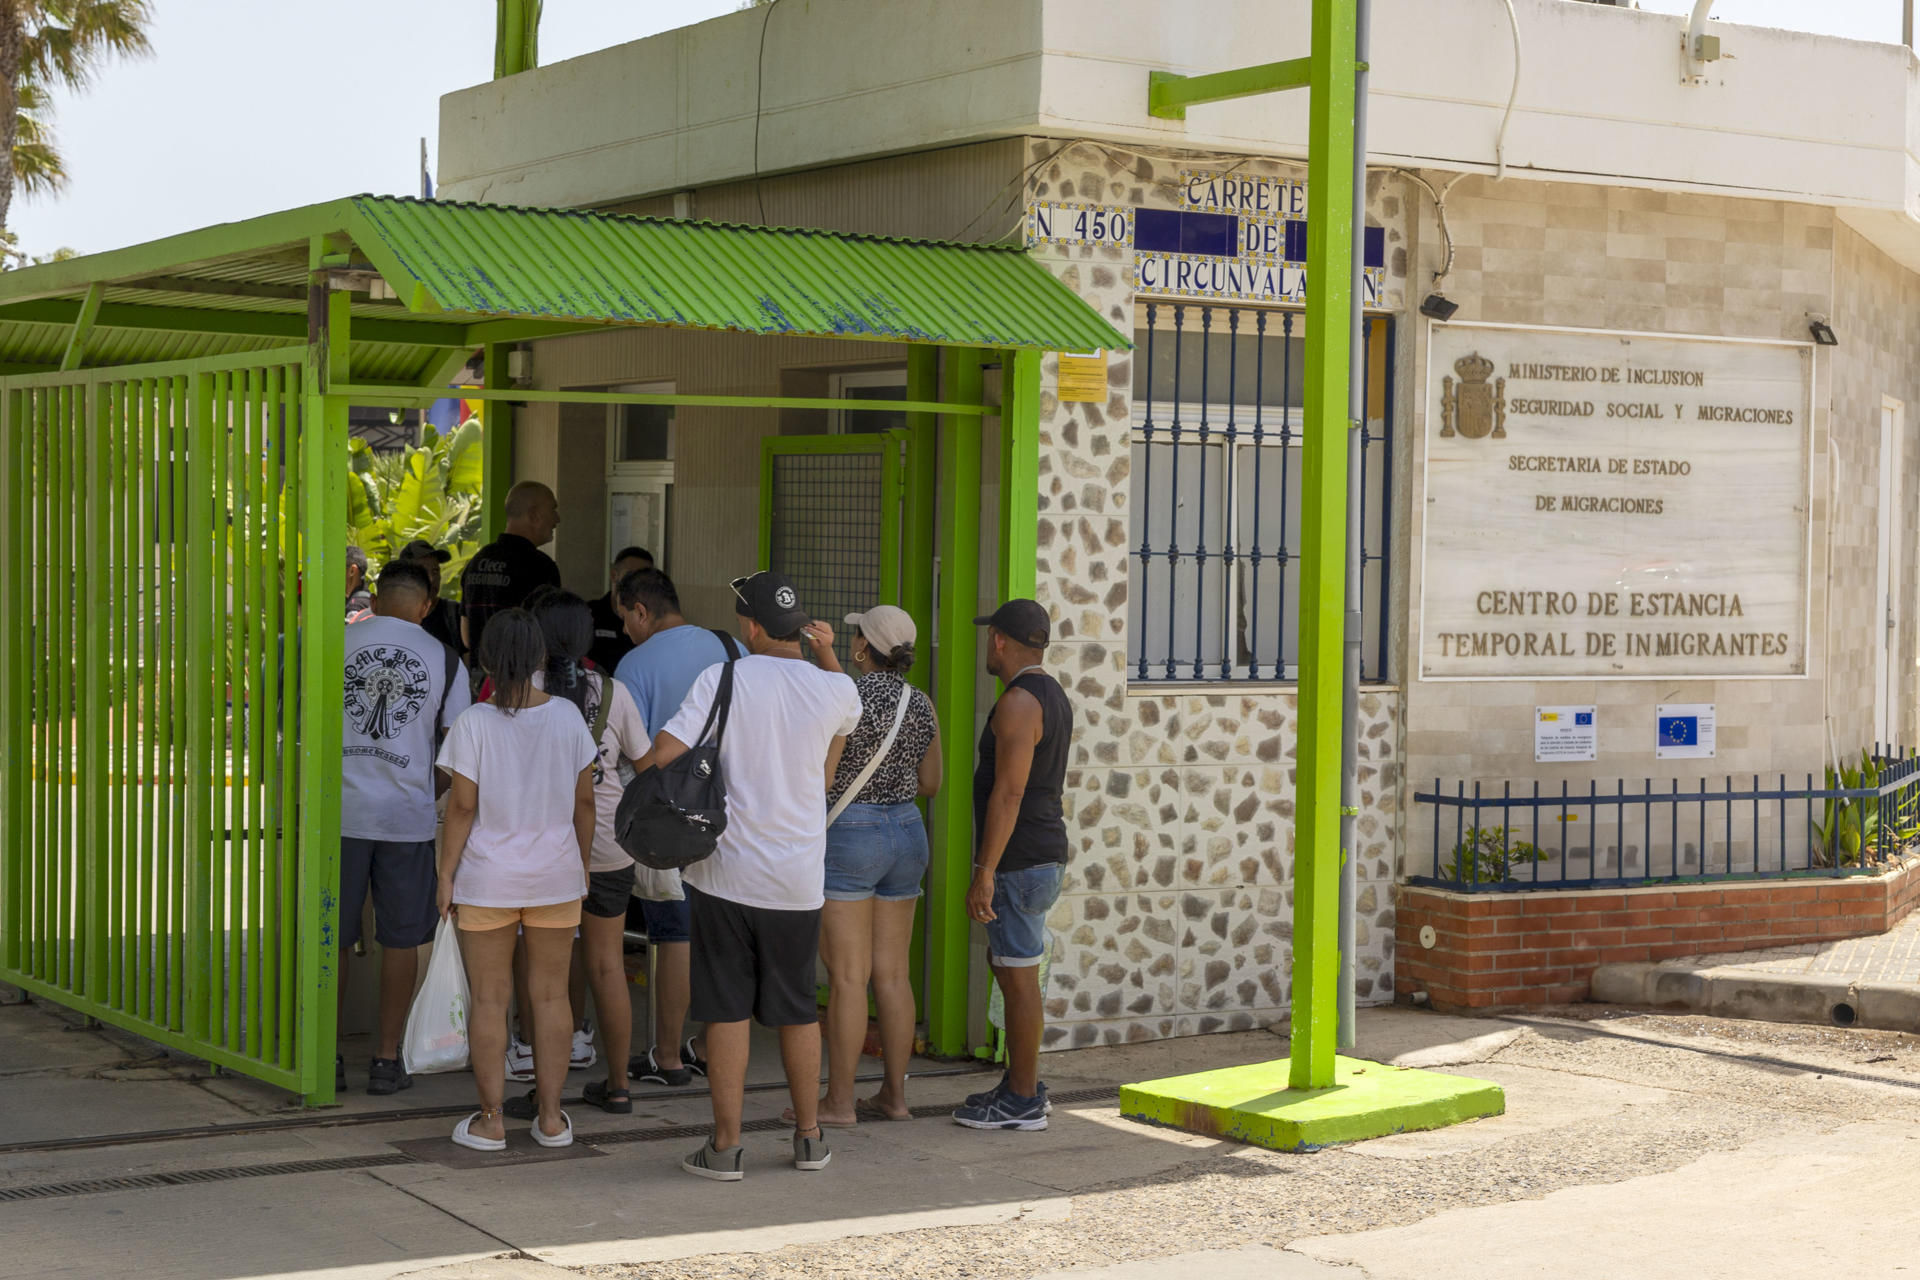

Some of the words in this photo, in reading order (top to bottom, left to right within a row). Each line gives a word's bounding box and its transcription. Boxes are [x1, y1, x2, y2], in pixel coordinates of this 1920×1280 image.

[1187, 177, 1304, 213] CARRETE
[1036, 207, 1052, 237] N
[1074, 211, 1126, 241] 450
[1246, 223, 1278, 253] DE
[1141, 258, 1376, 301] CIRCUNVALAN
[1508, 363, 1597, 383] MINISTERIO
[1600, 367, 1620, 384] DE
[1626, 368, 1704, 387] INCLUSION
[1509, 399, 1594, 417] SEGURIDAD
[1606, 403, 1663, 419] SOCIAL
[1675, 404, 1684, 419] Y
[1697, 405, 1793, 425] MIGRACIONES
[1508, 455, 1601, 473] SECRETARIA
[1607, 458, 1628, 474] DE
[1633, 459, 1691, 476] ESTADO
[1535, 495, 1556, 511] DE
[1561, 496, 1663, 514] MIGRACIONES
[1476, 590, 1577, 616] CENTRO
[1587, 592, 1619, 616] DE
[1630, 593, 1744, 617] ESTANCIA
[1438, 631, 1575, 657] TEMPORAL
[1586, 631, 1617, 657] DE
[1626, 631, 1789, 657] INMIGRANTES
